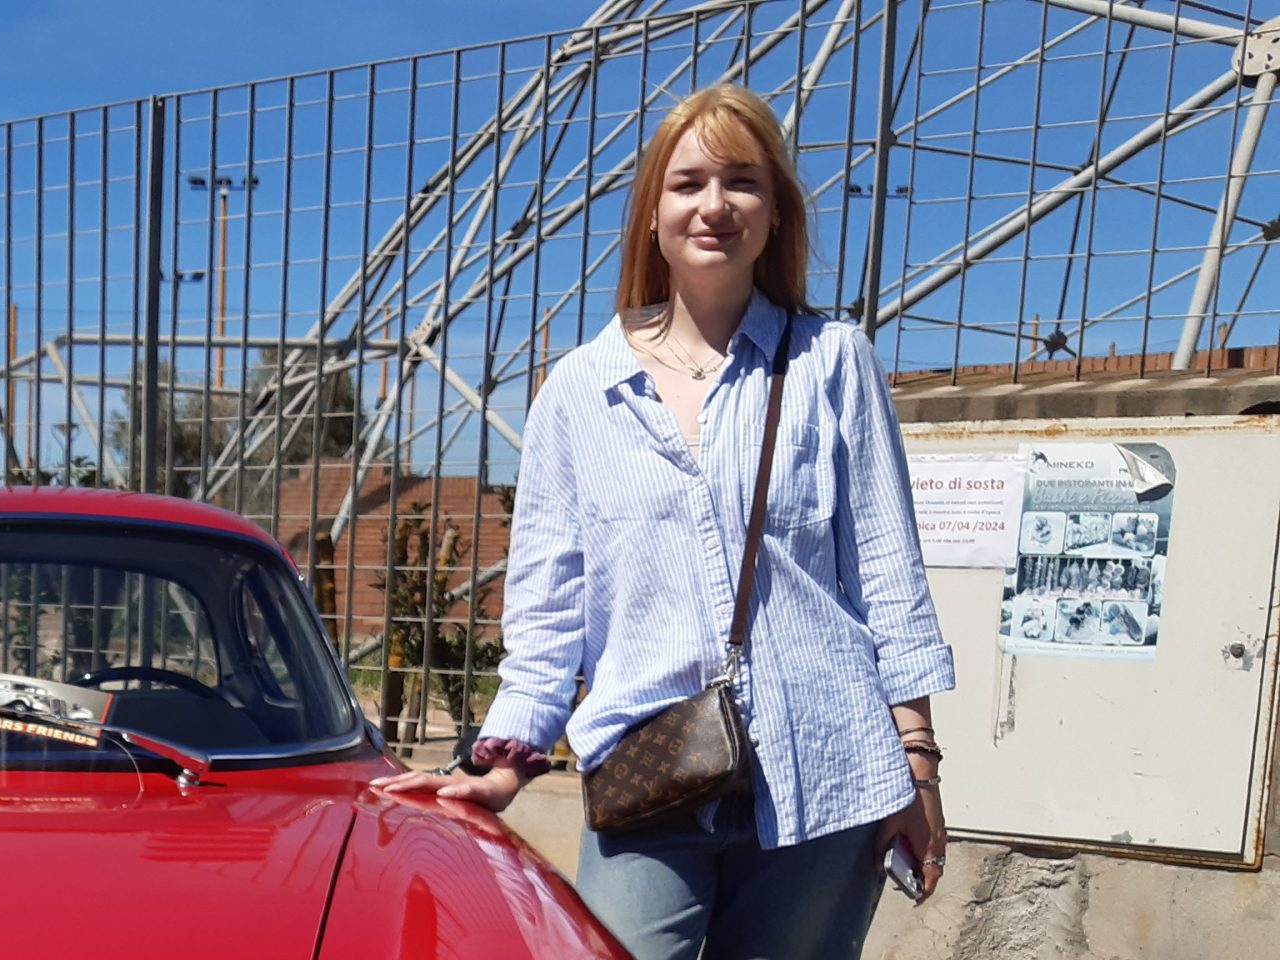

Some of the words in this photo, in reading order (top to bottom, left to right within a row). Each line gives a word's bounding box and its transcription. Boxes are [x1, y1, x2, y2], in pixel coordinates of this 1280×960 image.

[910, 477, 944, 490] vieto
[948, 477, 962, 490] di
[966, 477, 1005, 490] sosta
[26, 723, 98, 748] FRIENDS
